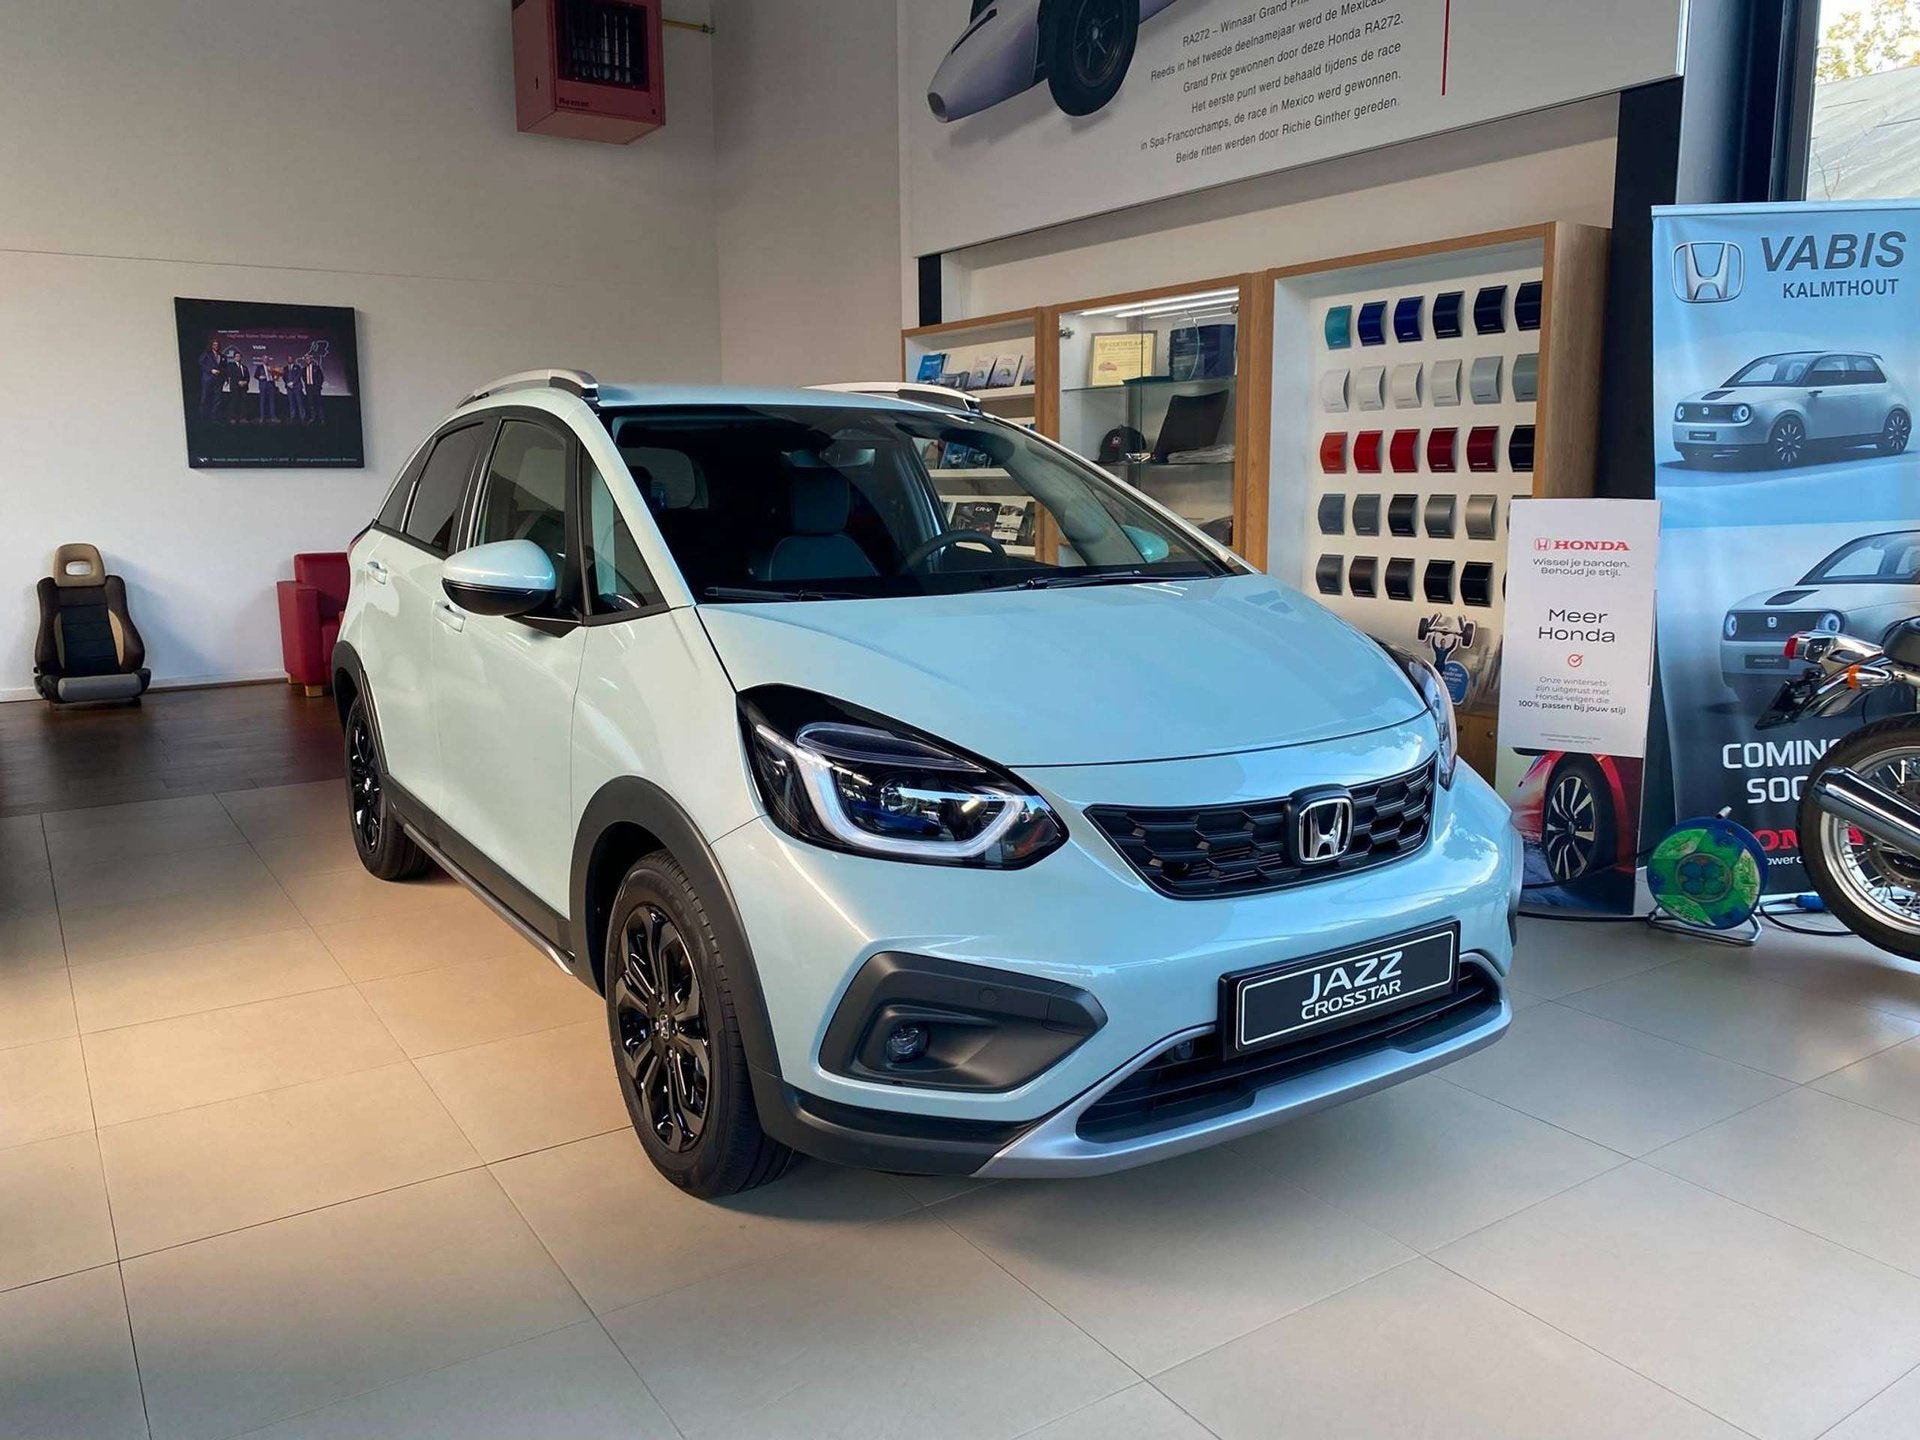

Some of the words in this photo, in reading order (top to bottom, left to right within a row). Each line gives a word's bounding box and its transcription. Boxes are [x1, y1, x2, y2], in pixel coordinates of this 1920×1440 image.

[1182, 28, 1210, 47] RA272
[1220, 12, 1256, 33] Winnaar
[1259, 0, 1287, 19] Grand
[1150, 64, 1176, 81] Reeds
[1177, 62, 1185, 71] in
[1187, 56, 1200, 68] het
[1202, 45, 1232, 63] tweede
[1235, 23, 1296, 52] deelnamejaar
[1298, 12, 1322, 30] werd
[1325, 9, 1338, 21] de
[1183, 74, 1208, 93] Grand
[1210, 71, 1227, 83] Prix
[1229, 55, 1275, 80] gewonnen
[1277, 48, 1298, 62] door
[1301, 40, 1325, 55] deze
[1328, 27, 1361, 46] Honda
[1365, 13, 1404, 34] RA272.
[1192, 101, 1206, 113] Het
[1208, 93, 1234, 109] eerste
[1237, 85, 1257, 102] punt
[1259, 76, 1281, 93] werd
[1284, 64, 1321, 85] behaald
[1325, 56, 1357, 75] tijdens
[1361, 50, 1374, 62] de
[1378, 42, 1401, 57] race
[1140, 141, 1148, 150] in
[1150, 118, 1231, 149] Spa-Francorchamps,
[1234, 112, 1245, 124] de
[1248, 107, 1267, 120] race
[1270, 103, 1278, 113] in
[1281, 94, 1315, 110] Mexico
[1318, 84, 1341, 100] werd
[1344, 70, 1401, 96] gewonnen.
[1176, 150, 1199, 163] Beide
[1201, 143, 1222, 156] ritten
[1225, 134, 1256, 150] werden
[1258, 128, 1279, 141] door
[1282, 120, 1311, 134] Richie
[1314, 109, 1351, 126] Ginther
[1354, 98, 1400, 119] gereden.
[1761, 231, 1906, 272] VABIS
[1783, 278, 1899, 298] KALMTHOUT
[1554, 540, 1630, 551] HONDA
[1541, 567, 1584, 575] Behoud
[1585, 569, 1596, 577] je
[1570, 559, 1581, 568] je
[1584, 560, 1630, 568] banden.
[1548, 608, 1608, 623] Meer
[1538, 626, 1615, 643] Honda
[1536, 685, 1550, 693] zijn
[1552, 686, 1591, 695] uitgerust
[1592, 687, 1610, 696] met
[1540, 676, 1561, 684] Onze
[1563, 679, 1607, 687] wintersets
[1518, 700, 1540, 708] 100%
[1541, 702, 1572, 711] passen
[1573, 704, 1585, 712] bij
[1586, 705, 1609, 713] jouw
[1596, 696, 1610, 704] die
[1722, 738, 1841, 769] COMIN
[1301, 951, 1402, 1007] JAZZ
[1301, 979, 1401, 1020] CROSSTAR
